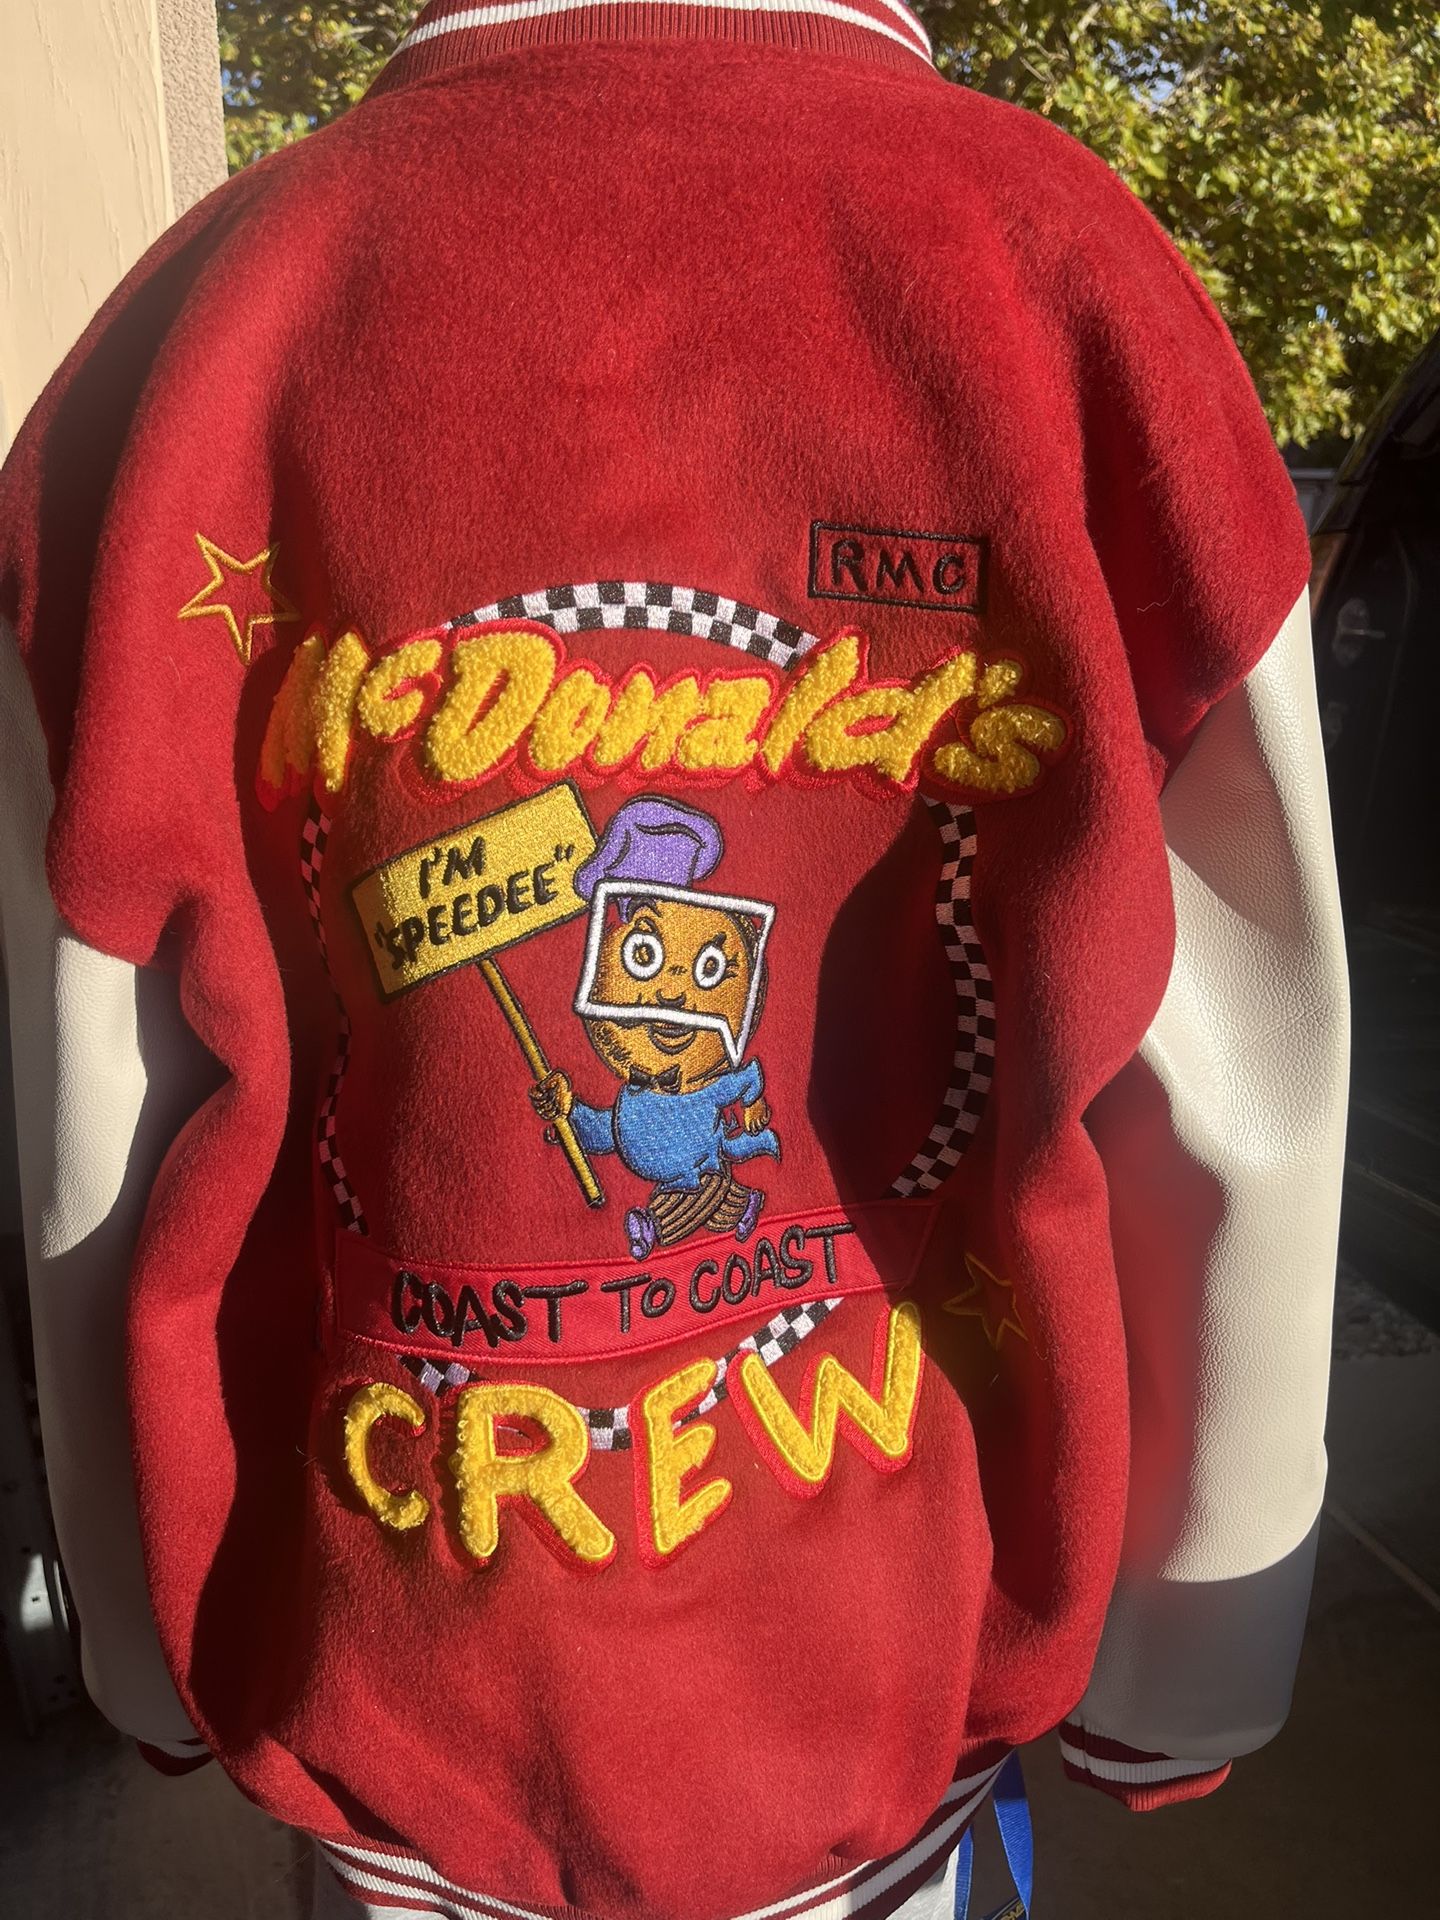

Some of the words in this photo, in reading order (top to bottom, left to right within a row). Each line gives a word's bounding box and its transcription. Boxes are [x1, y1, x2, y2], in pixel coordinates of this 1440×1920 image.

[831, 539, 966, 595] RMC
[258, 628, 1068, 795] McDonald's
[418, 836, 486, 899] I'M
[390, 1269, 588, 1348] COAST
[689, 1223, 856, 1313] COAST
[343, 1302, 922, 1564] CREW
